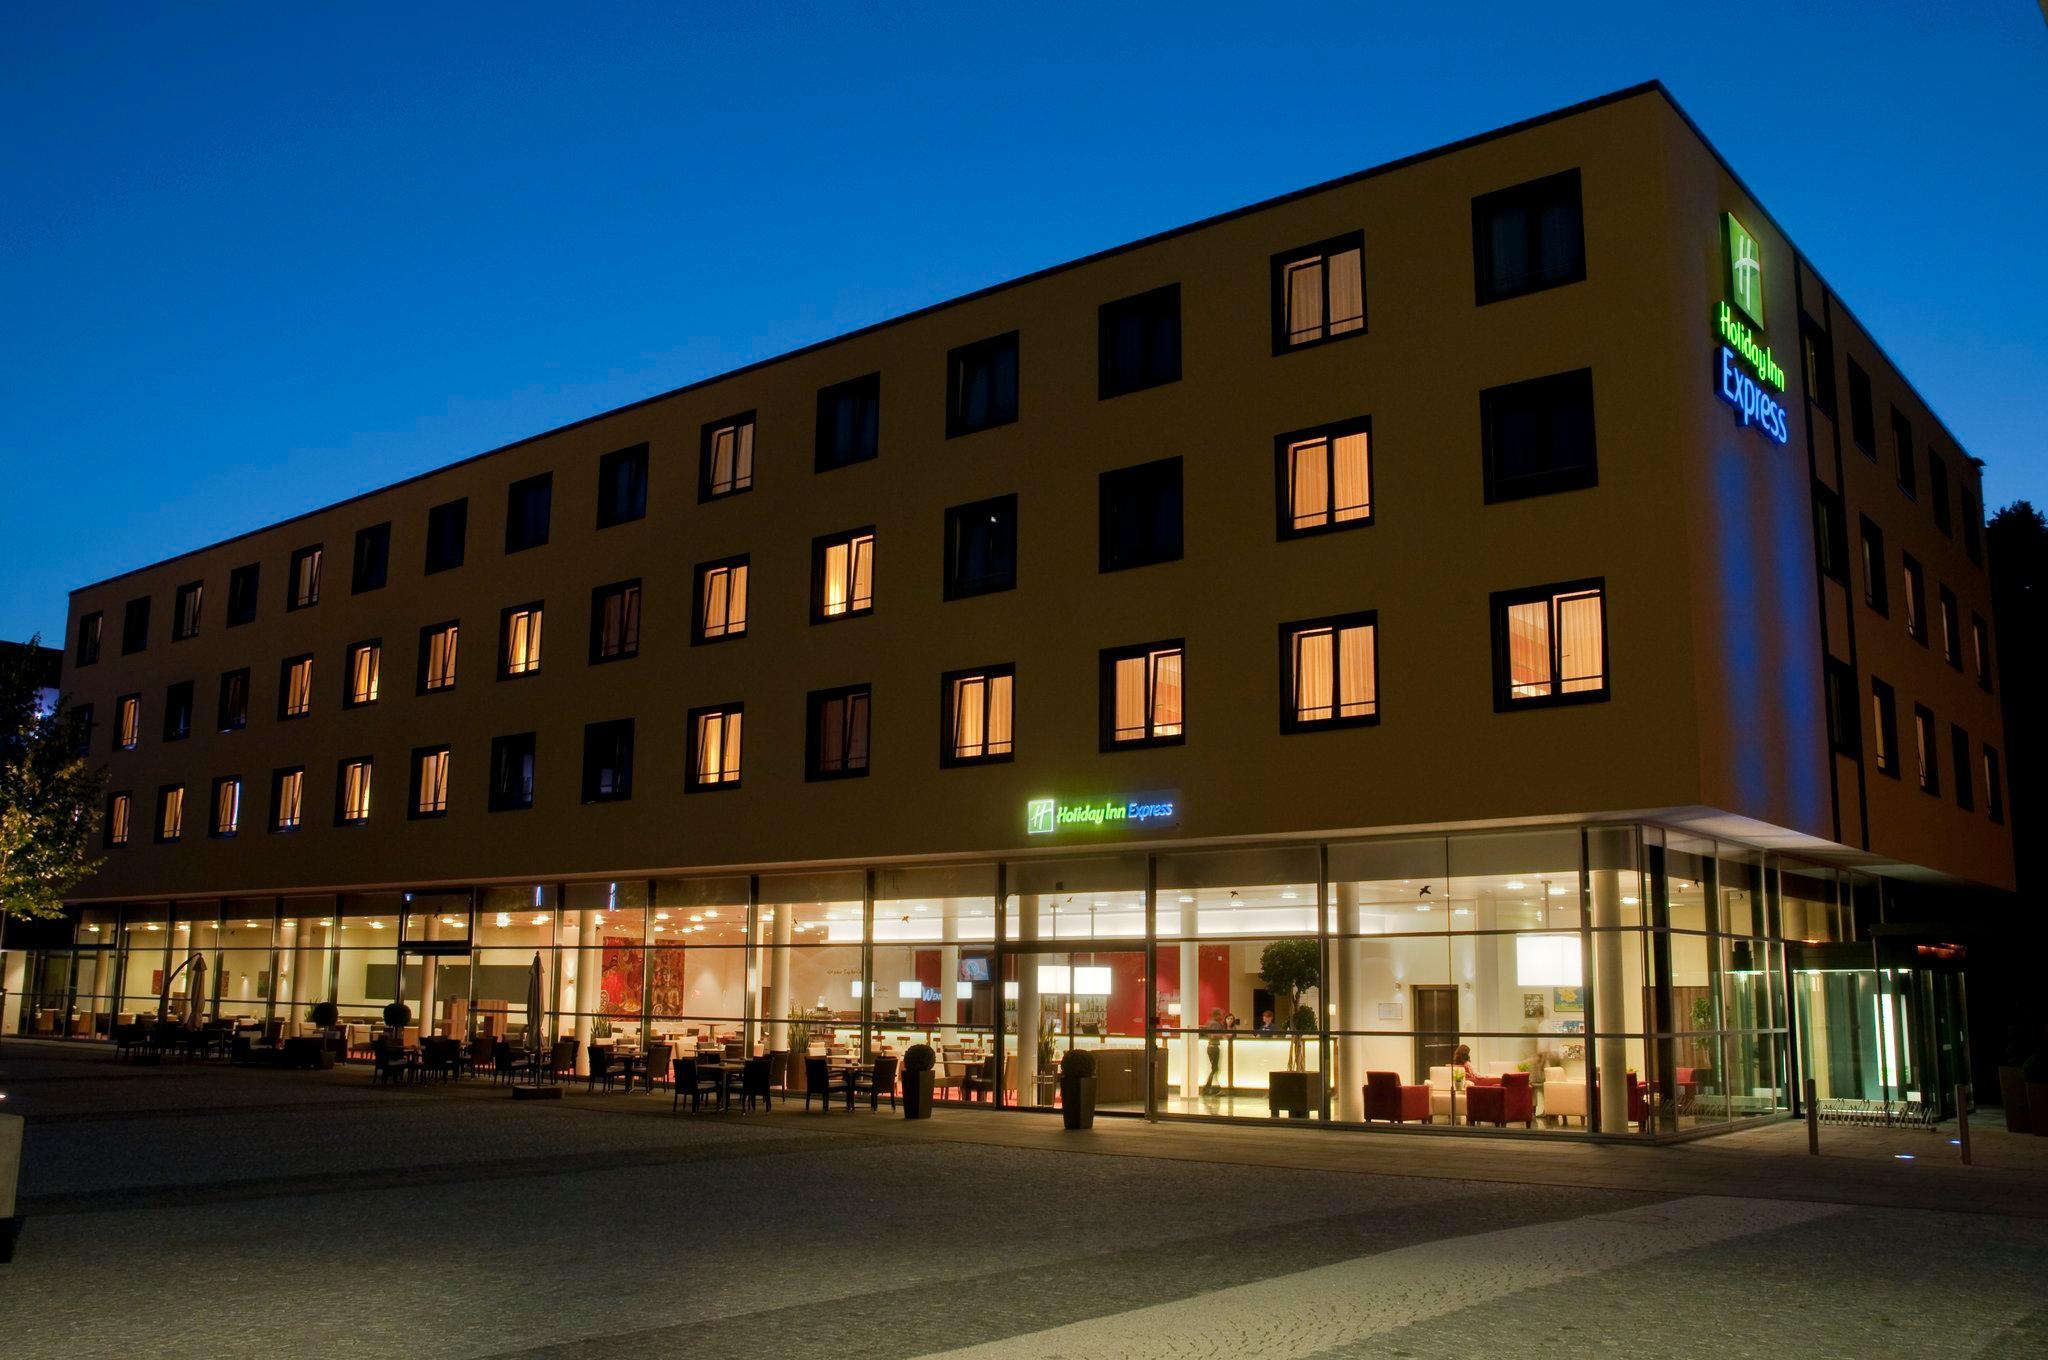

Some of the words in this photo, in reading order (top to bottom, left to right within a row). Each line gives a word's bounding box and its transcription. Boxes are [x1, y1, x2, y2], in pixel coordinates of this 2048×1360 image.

[1720, 300, 1766, 380] Holiday
[1766, 346, 1785, 392] Inn
[1722, 346, 1787, 443] Express
[1056, 805, 1105, 824] Holiday
[1105, 802, 1126, 819] Inn
[1128, 802, 1173, 821] Express
